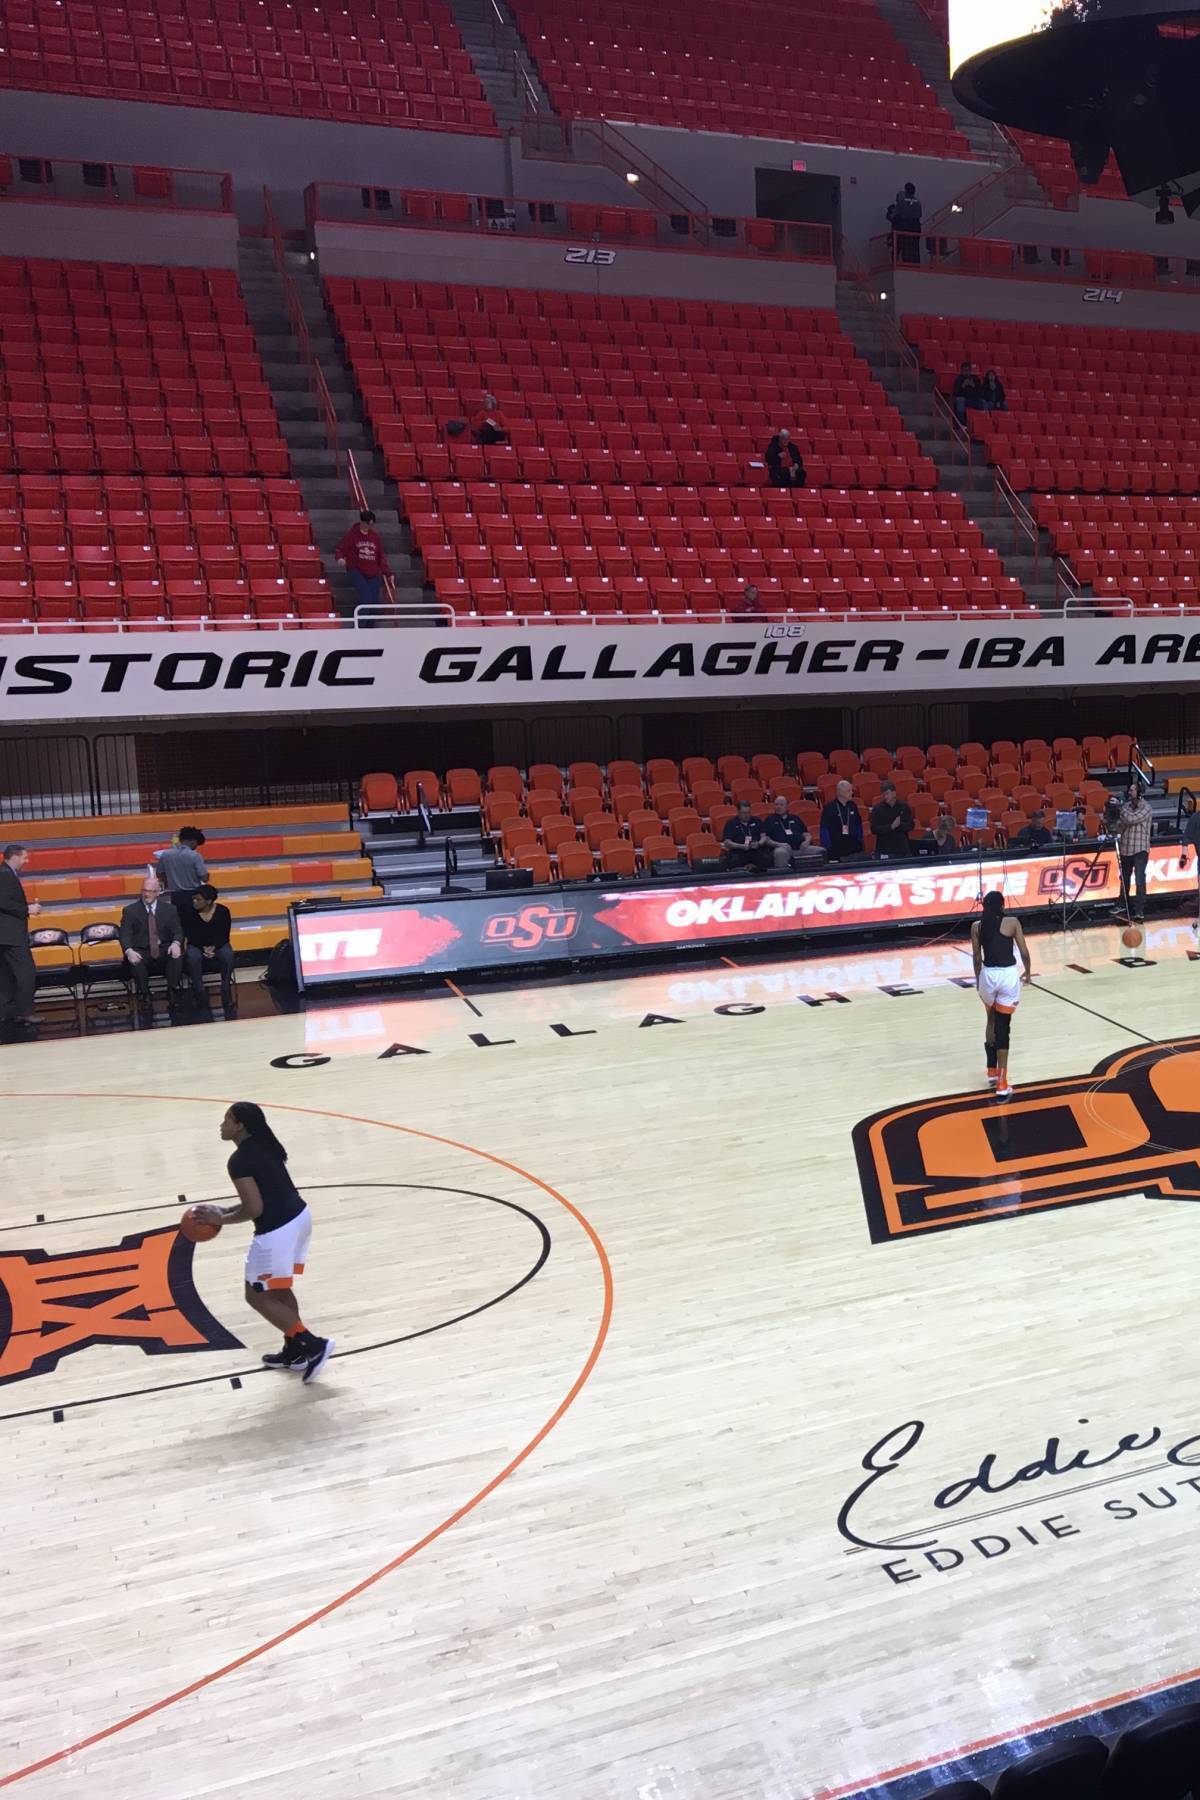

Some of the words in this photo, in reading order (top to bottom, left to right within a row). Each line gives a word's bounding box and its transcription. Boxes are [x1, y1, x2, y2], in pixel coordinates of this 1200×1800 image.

[565, 248, 616, 265] 213
[1083, 288, 1123, 303] 214
[765, 624, 806, 638] 108
[0, 649, 384, 695] STORIC
[481, 906, 581, 950] OSU
[666, 884, 904, 928] OKLAHOMA
[910, 872, 1029, 906] STATE
[1039, 858, 1111, 898] OSU
[881, 1515, 1081, 1585] EDDIE
